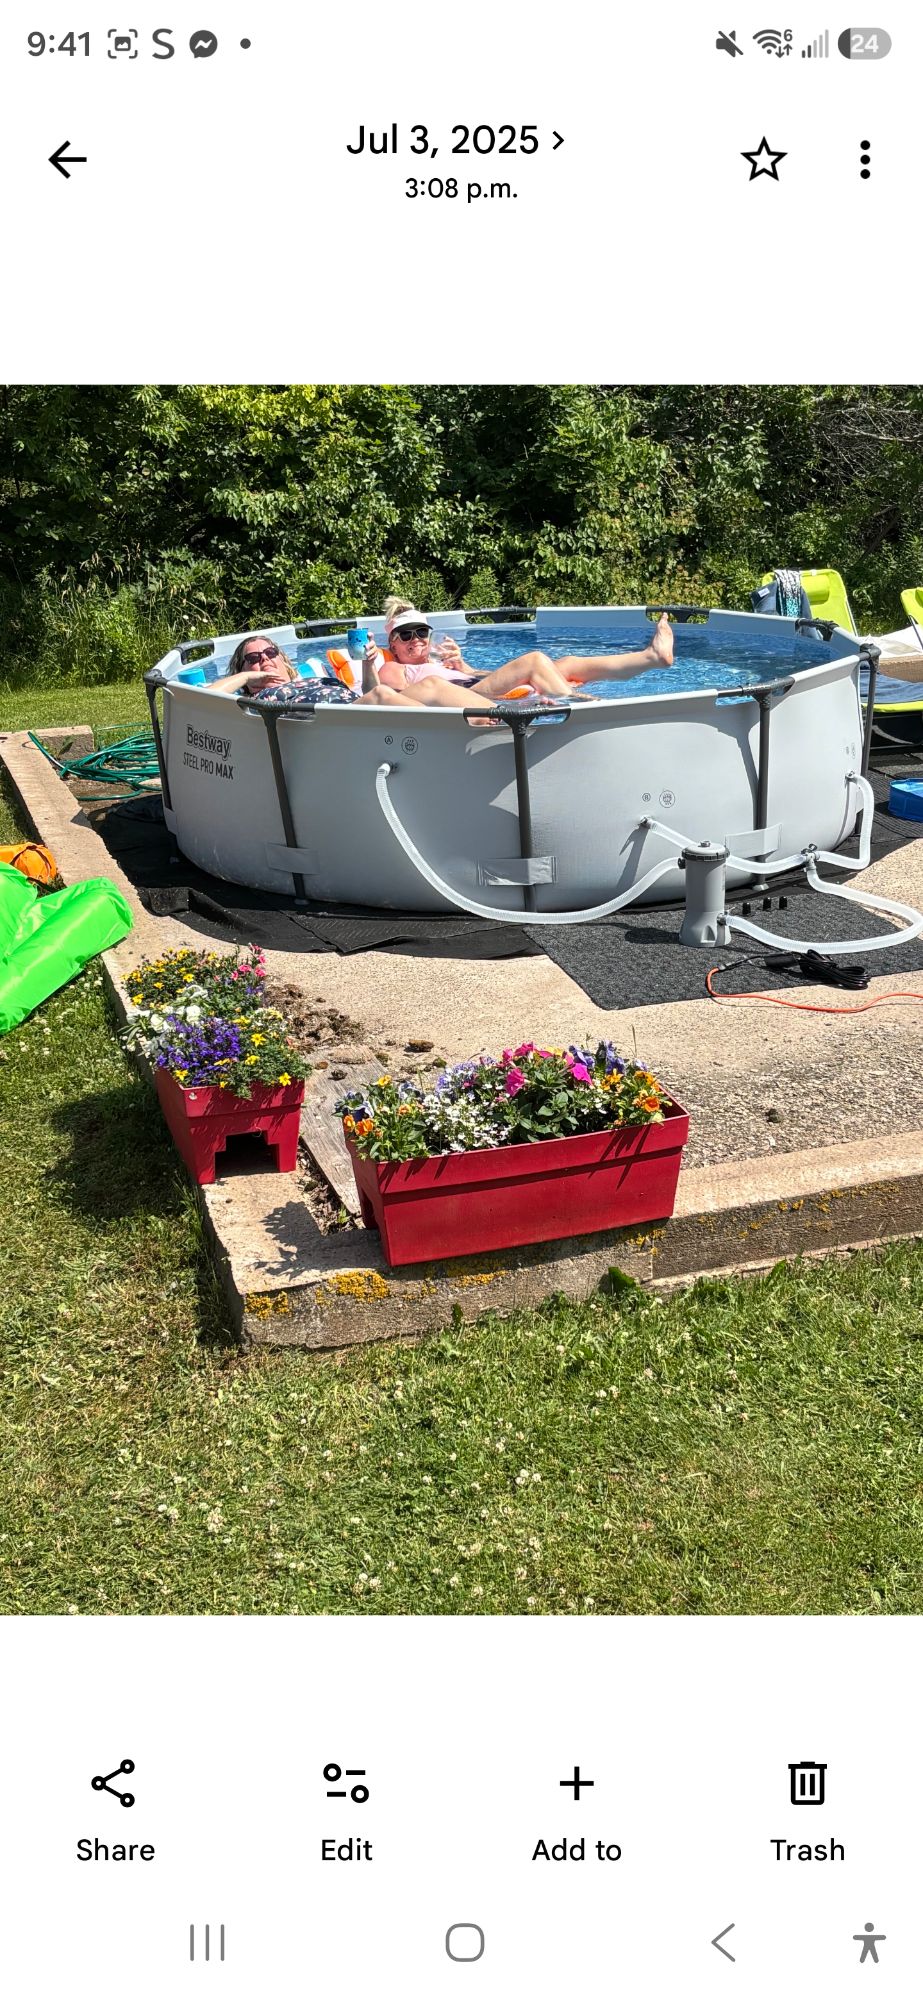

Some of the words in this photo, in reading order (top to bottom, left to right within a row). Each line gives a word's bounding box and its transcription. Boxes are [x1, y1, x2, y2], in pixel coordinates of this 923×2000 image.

[186, 724, 231, 761] Bestway
[183, 752, 199, 770] STEEL
[200, 758, 214, 774] PRO
[215, 762, 234, 780] MAX
